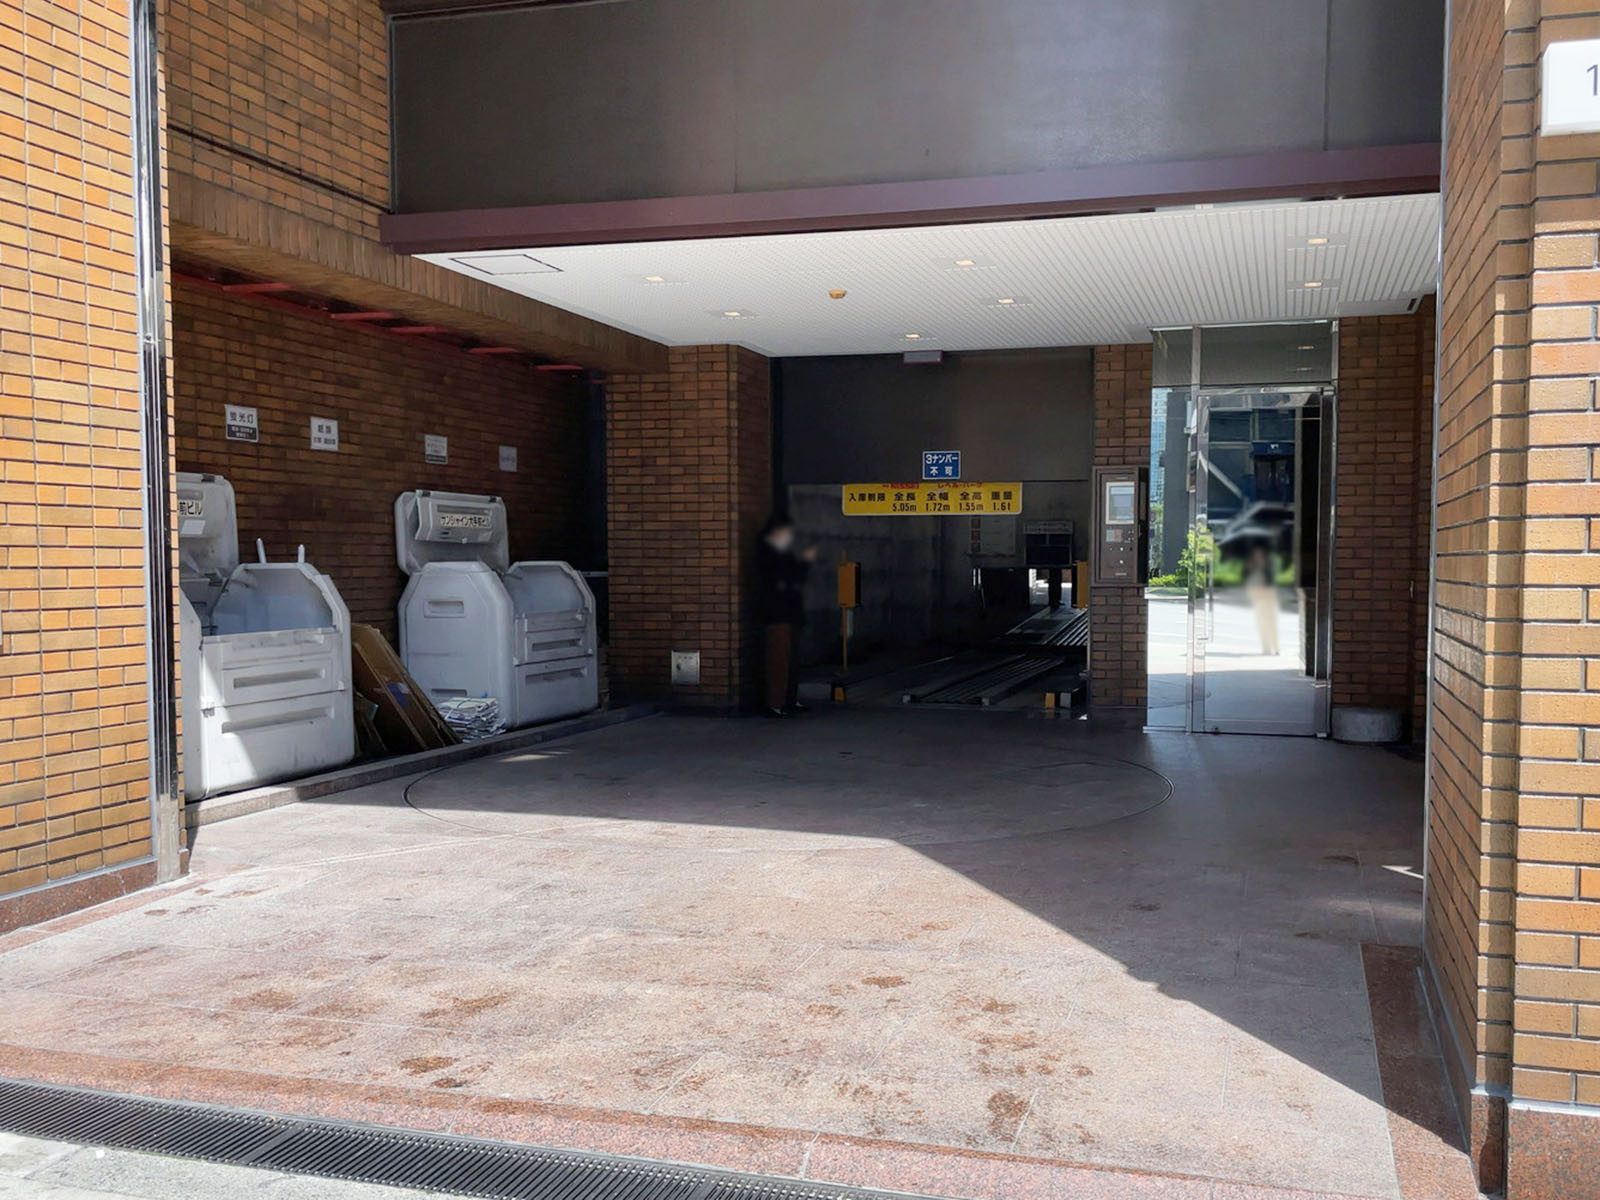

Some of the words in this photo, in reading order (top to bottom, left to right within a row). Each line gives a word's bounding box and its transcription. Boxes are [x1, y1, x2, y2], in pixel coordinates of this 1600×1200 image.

[925, 454, 958, 463] 3ナンバー
[894, 491, 916, 501] 全長
[927, 491, 949, 501] 全幅
[960, 491, 982, 500] 全高
[892, 503, 917, 512] 5.05m
[925, 502, 950, 511] 1.72m
[959, 502, 984, 511] 1.55m
[992, 502, 1011, 511] 1.6t
